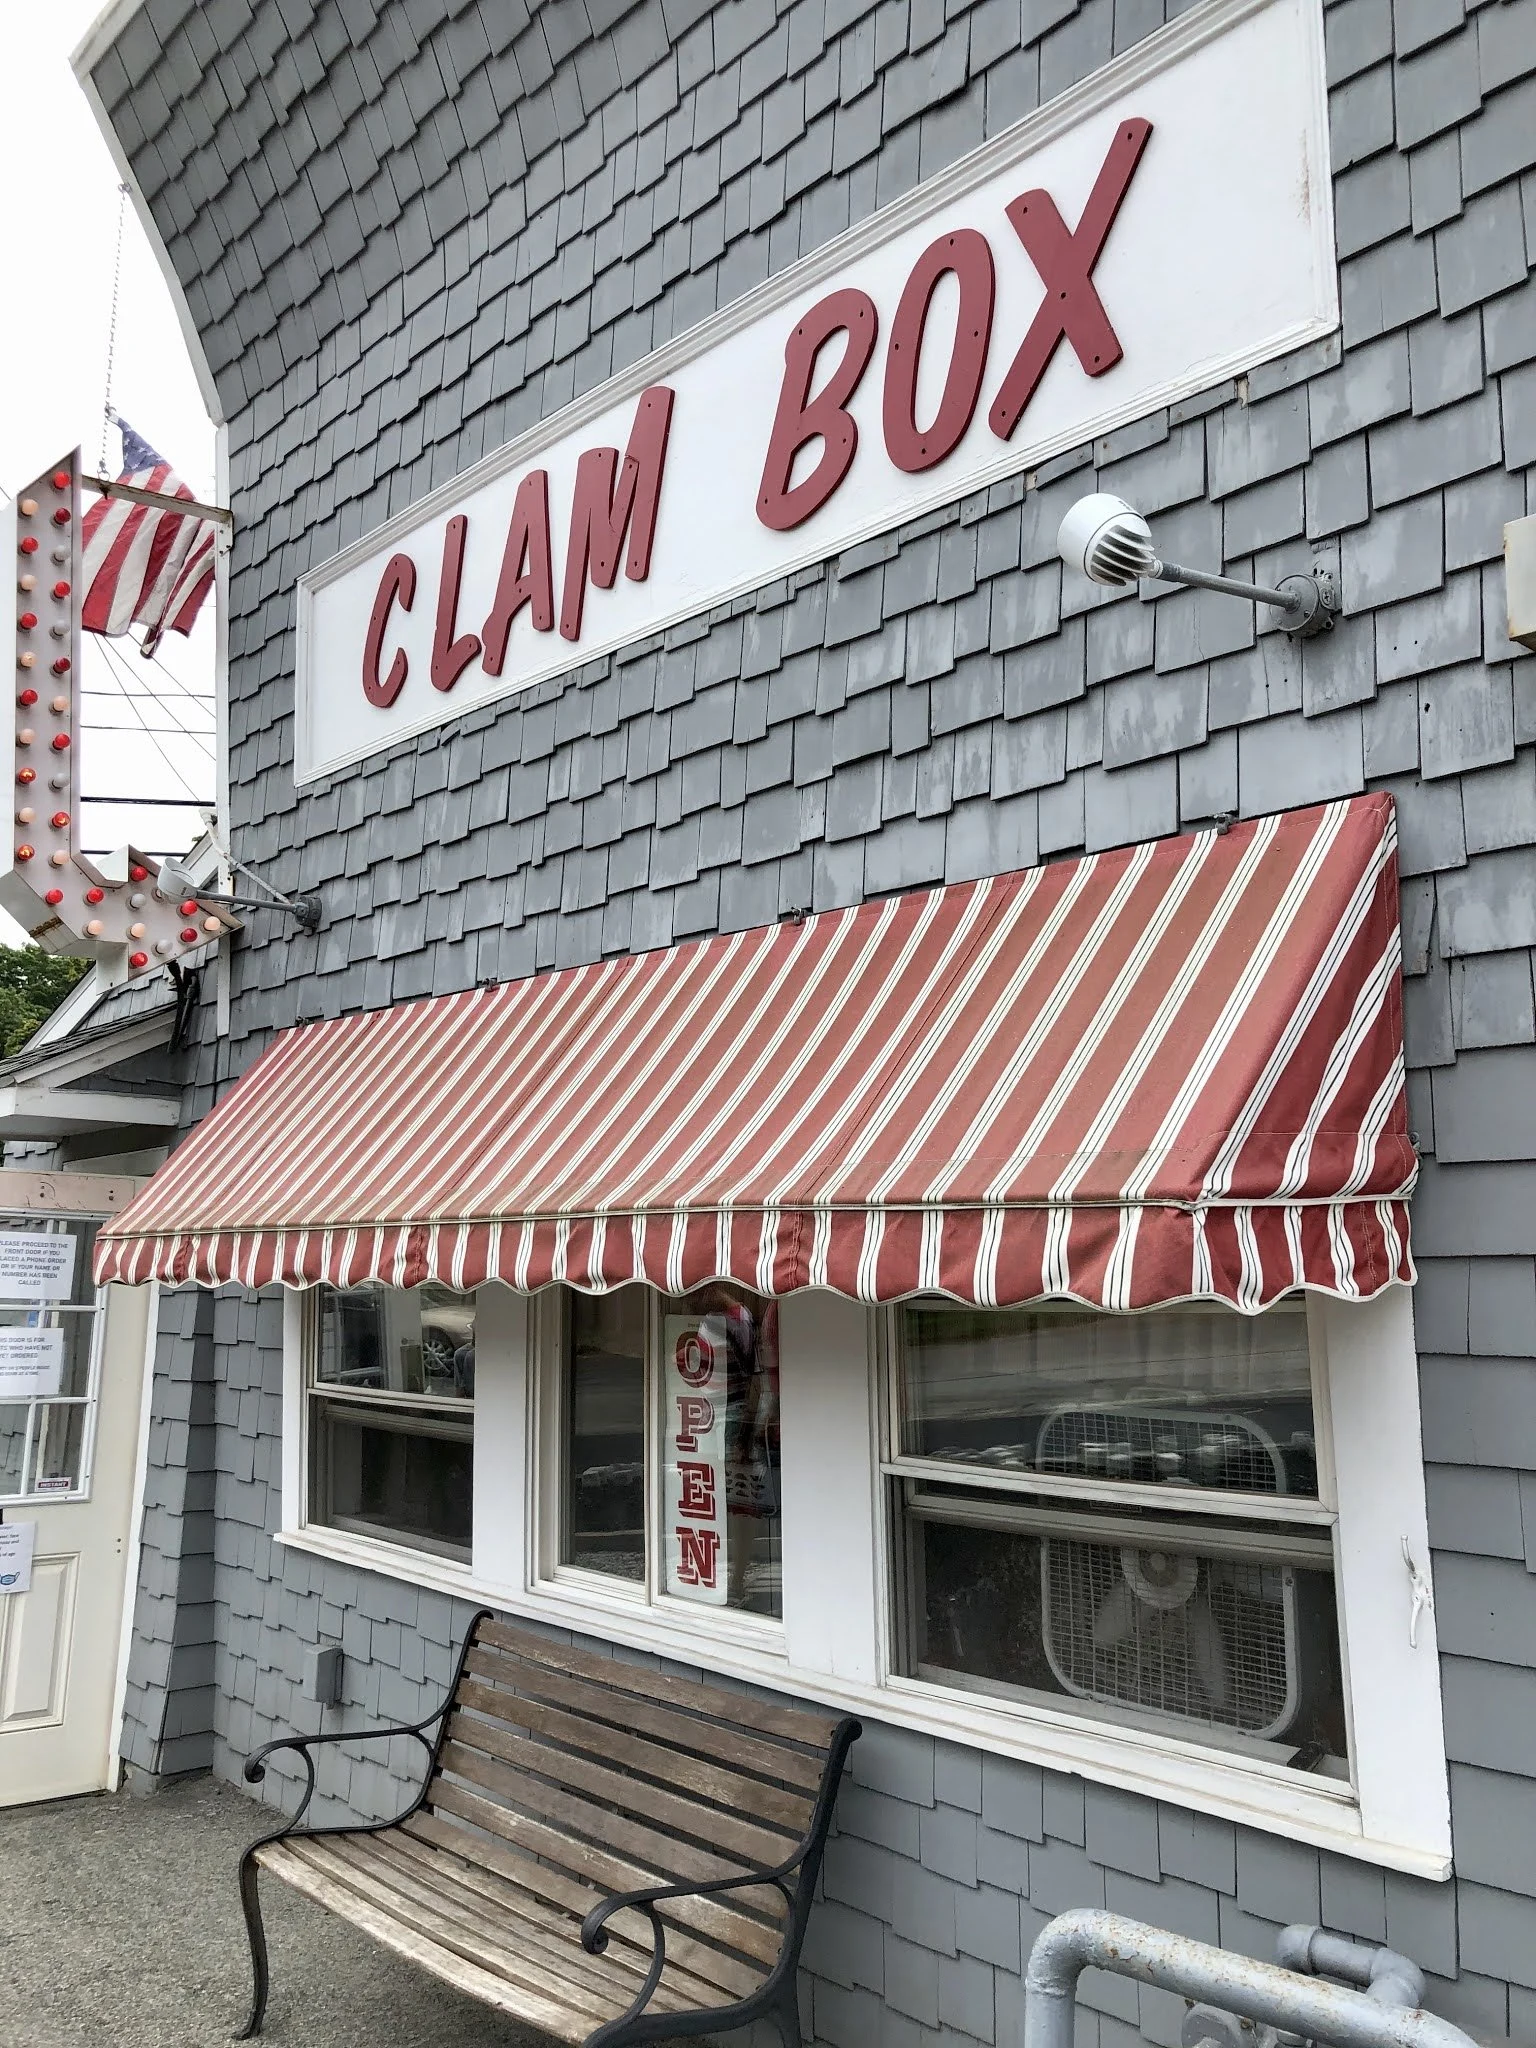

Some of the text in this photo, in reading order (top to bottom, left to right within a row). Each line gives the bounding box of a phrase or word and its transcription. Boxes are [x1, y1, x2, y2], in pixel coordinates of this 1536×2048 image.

[361, 116, 1153, 709] CLAM BOX
[675, 1330, 720, 1589] OPEN
